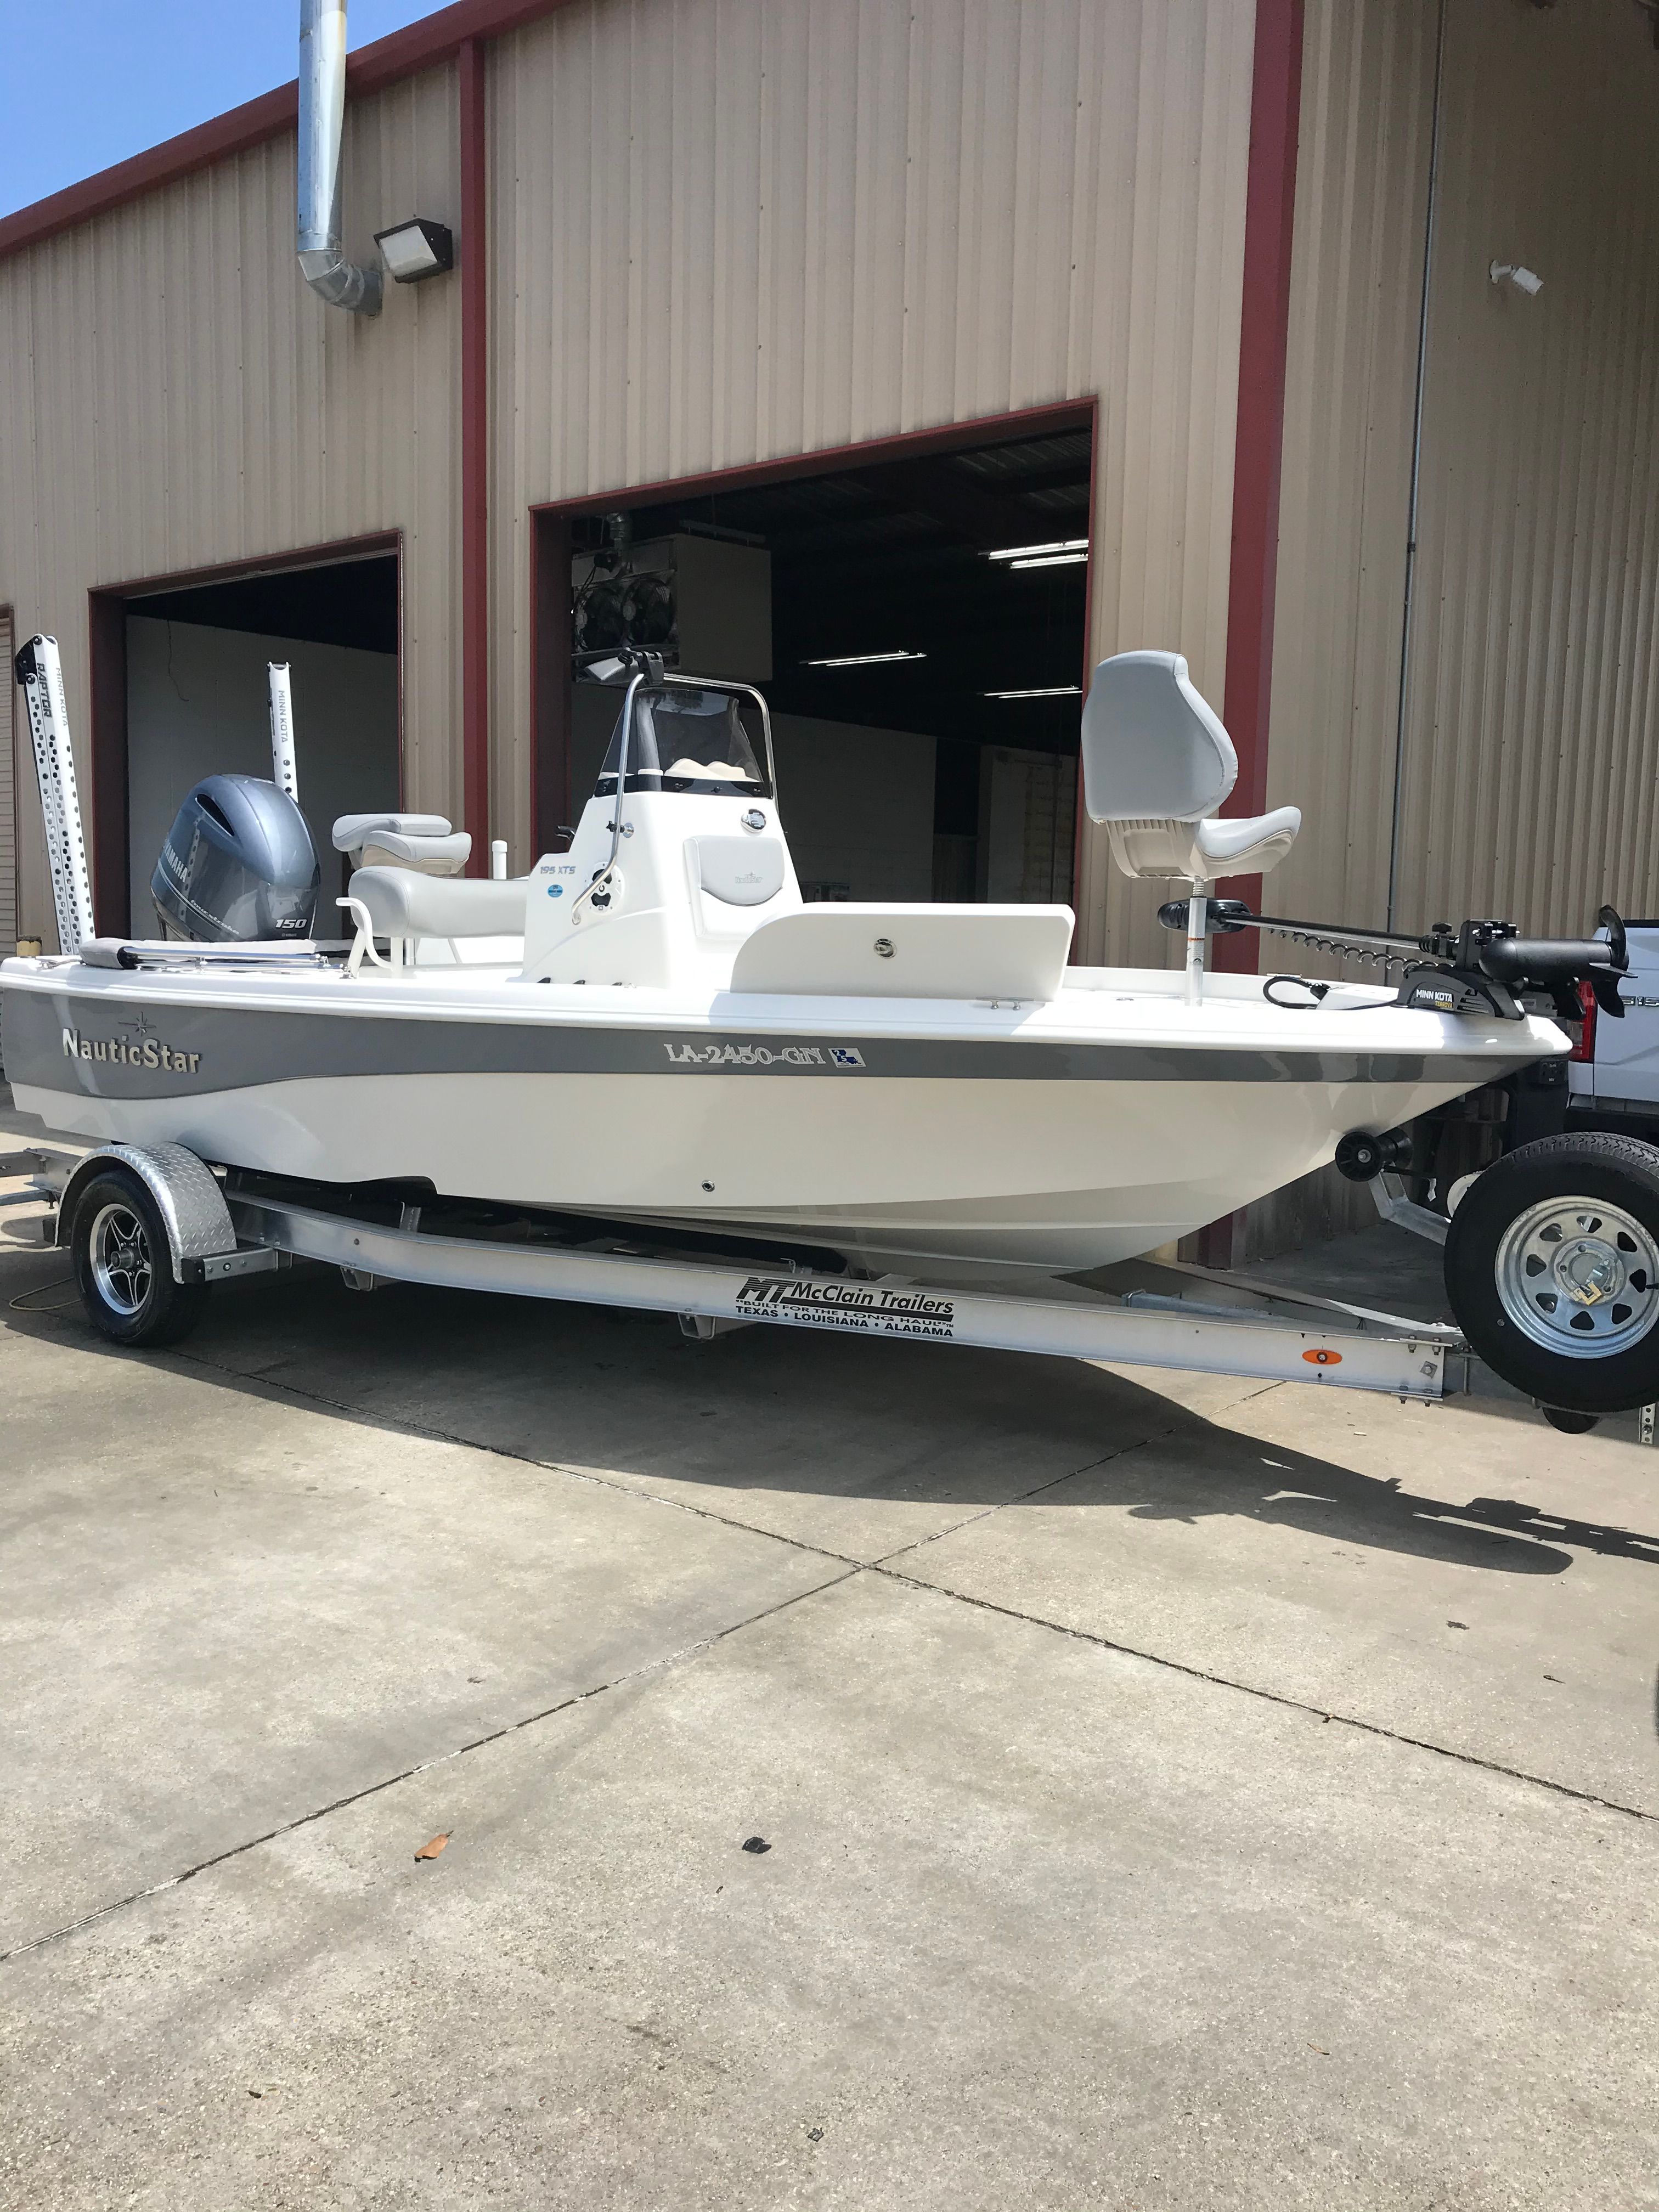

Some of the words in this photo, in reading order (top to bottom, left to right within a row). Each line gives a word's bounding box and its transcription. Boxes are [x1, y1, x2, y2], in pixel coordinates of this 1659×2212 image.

[37, 663, 52, 718] RAPTOR
[278, 690, 286, 715] MINN
[280, 718, 288, 743] KOTA
[275, 919, 307, 928] 150
[1416, 989, 1434, 1000] MINN
[1435, 991, 1453, 1002] KOTA
[63, 1028, 200, 1074] NauticStar
[791, 1282, 873, 1305] McClain
[880, 1290, 955, 1313] Trailers
[736, 1306, 778, 1317] TEXAS
[794, 1312, 868, 1328] LOUISIANA
[884, 1323, 953, 1337] ALABAMA
[782, 1304, 810, 1312] FOR
[844, 1312, 894, 1322] LONG
